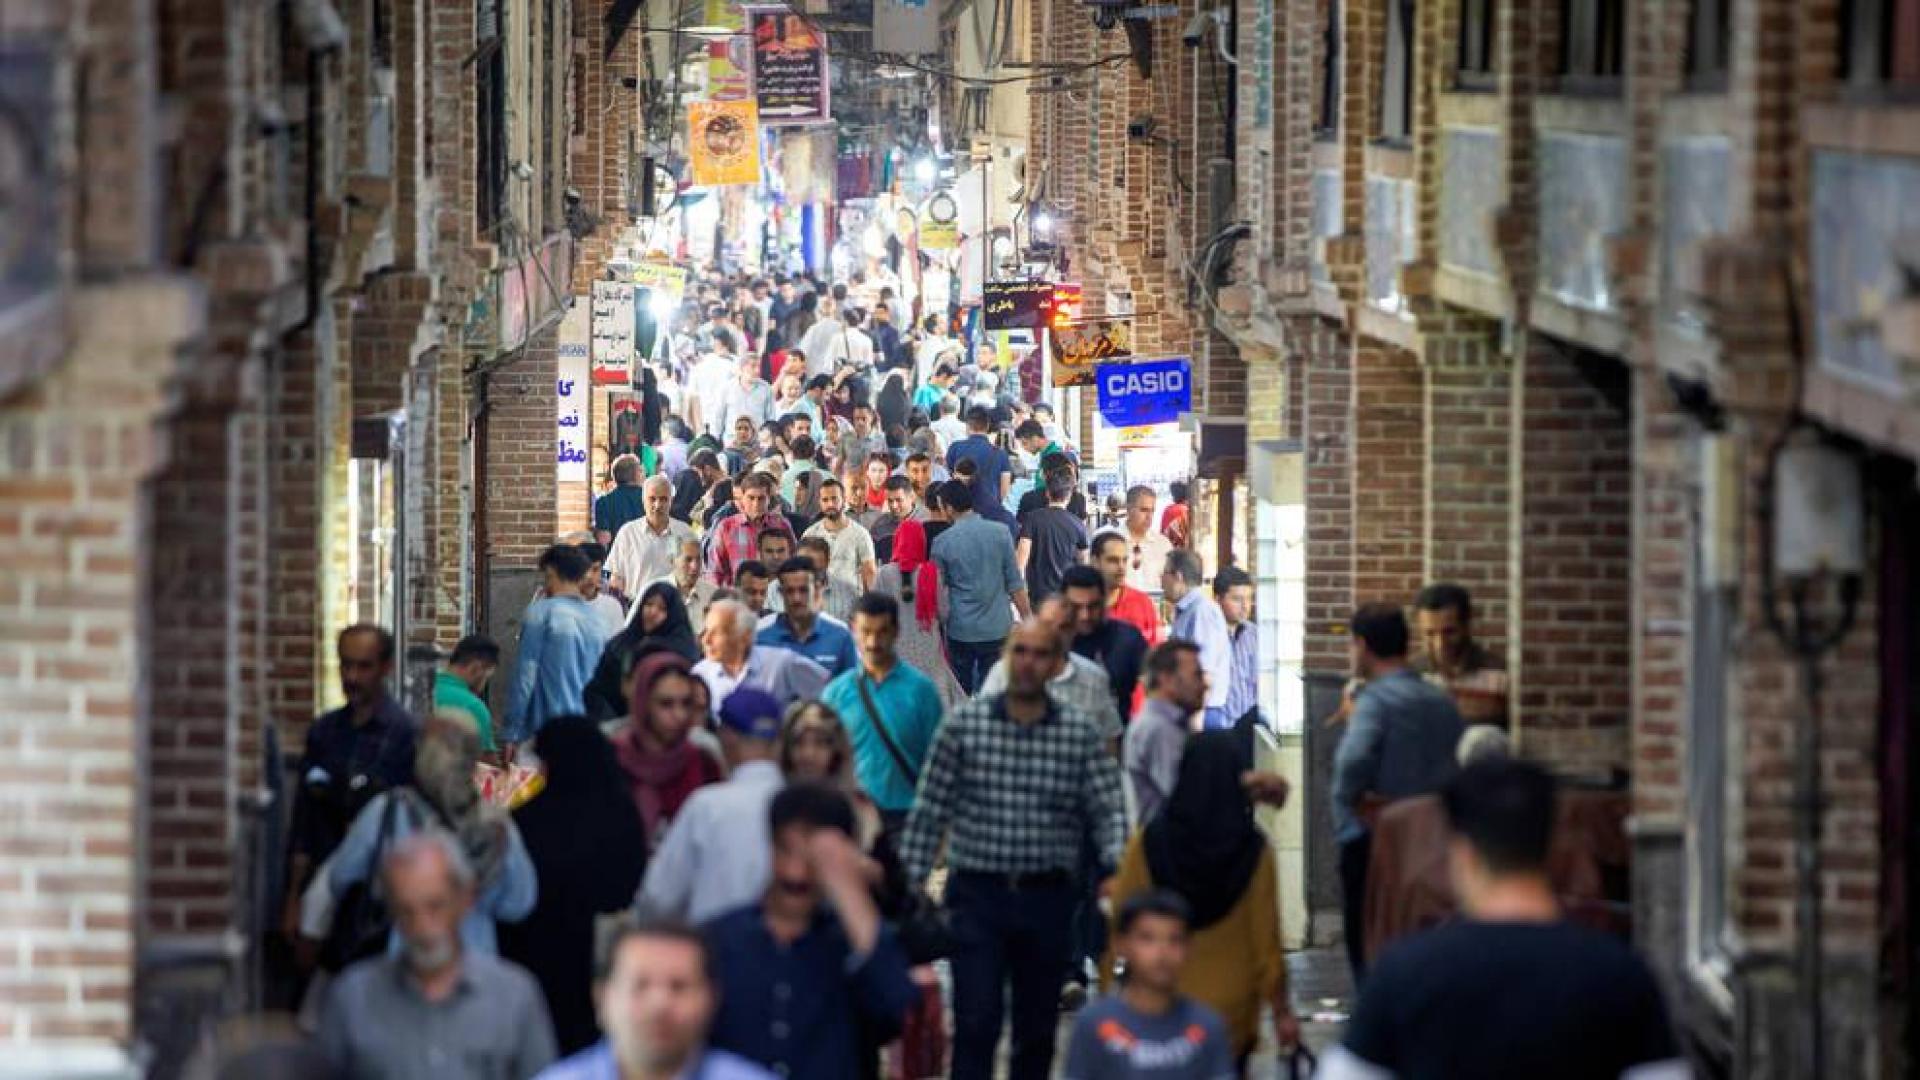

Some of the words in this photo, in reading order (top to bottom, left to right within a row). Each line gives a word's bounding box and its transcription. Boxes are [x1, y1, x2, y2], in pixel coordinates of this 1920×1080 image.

[1107, 370, 1184, 397] CASIO
[558, 408, 579, 428] نص
[558, 440, 587, 462] مظ
